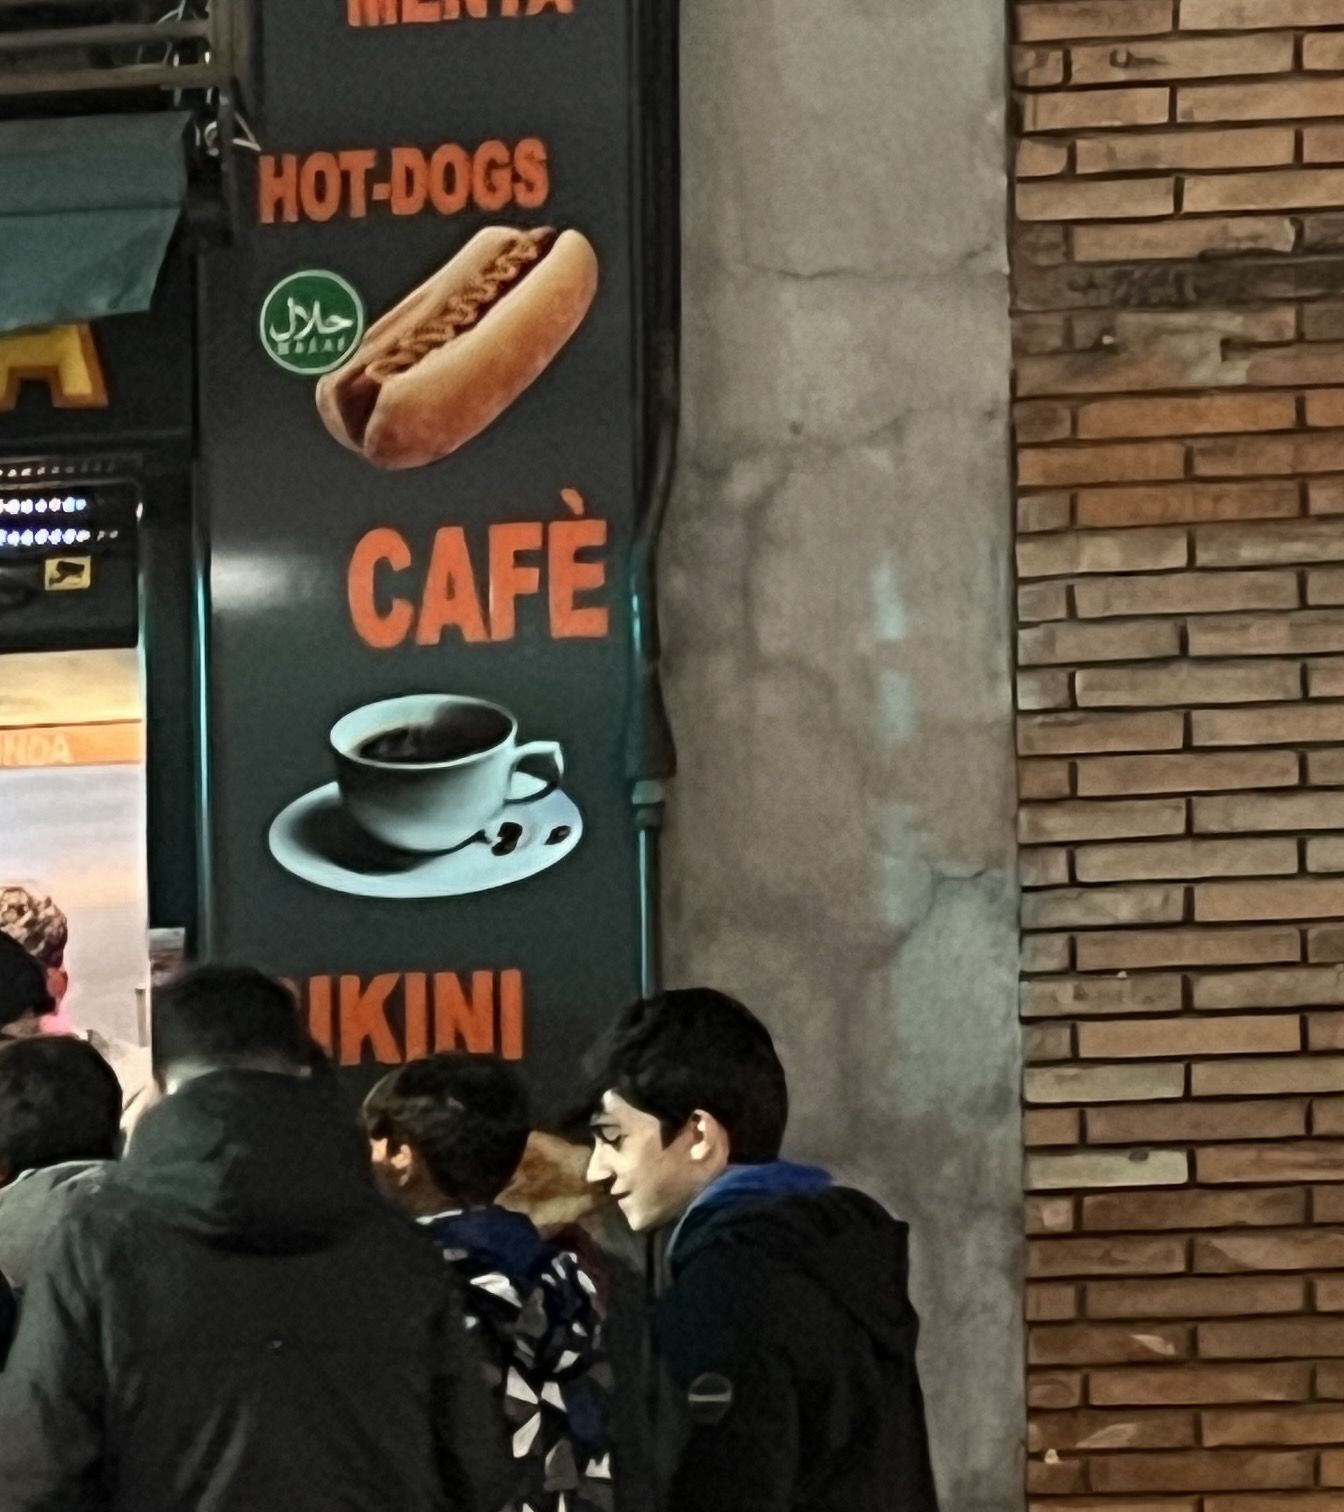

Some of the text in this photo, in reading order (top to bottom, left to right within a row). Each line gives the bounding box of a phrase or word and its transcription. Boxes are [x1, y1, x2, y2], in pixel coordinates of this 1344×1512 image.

[259, 138, 549, 224] HOT-DOGS
[348, 488, 609, 648] CAFÈ
[279, 968, 523, 1067] IKINI
